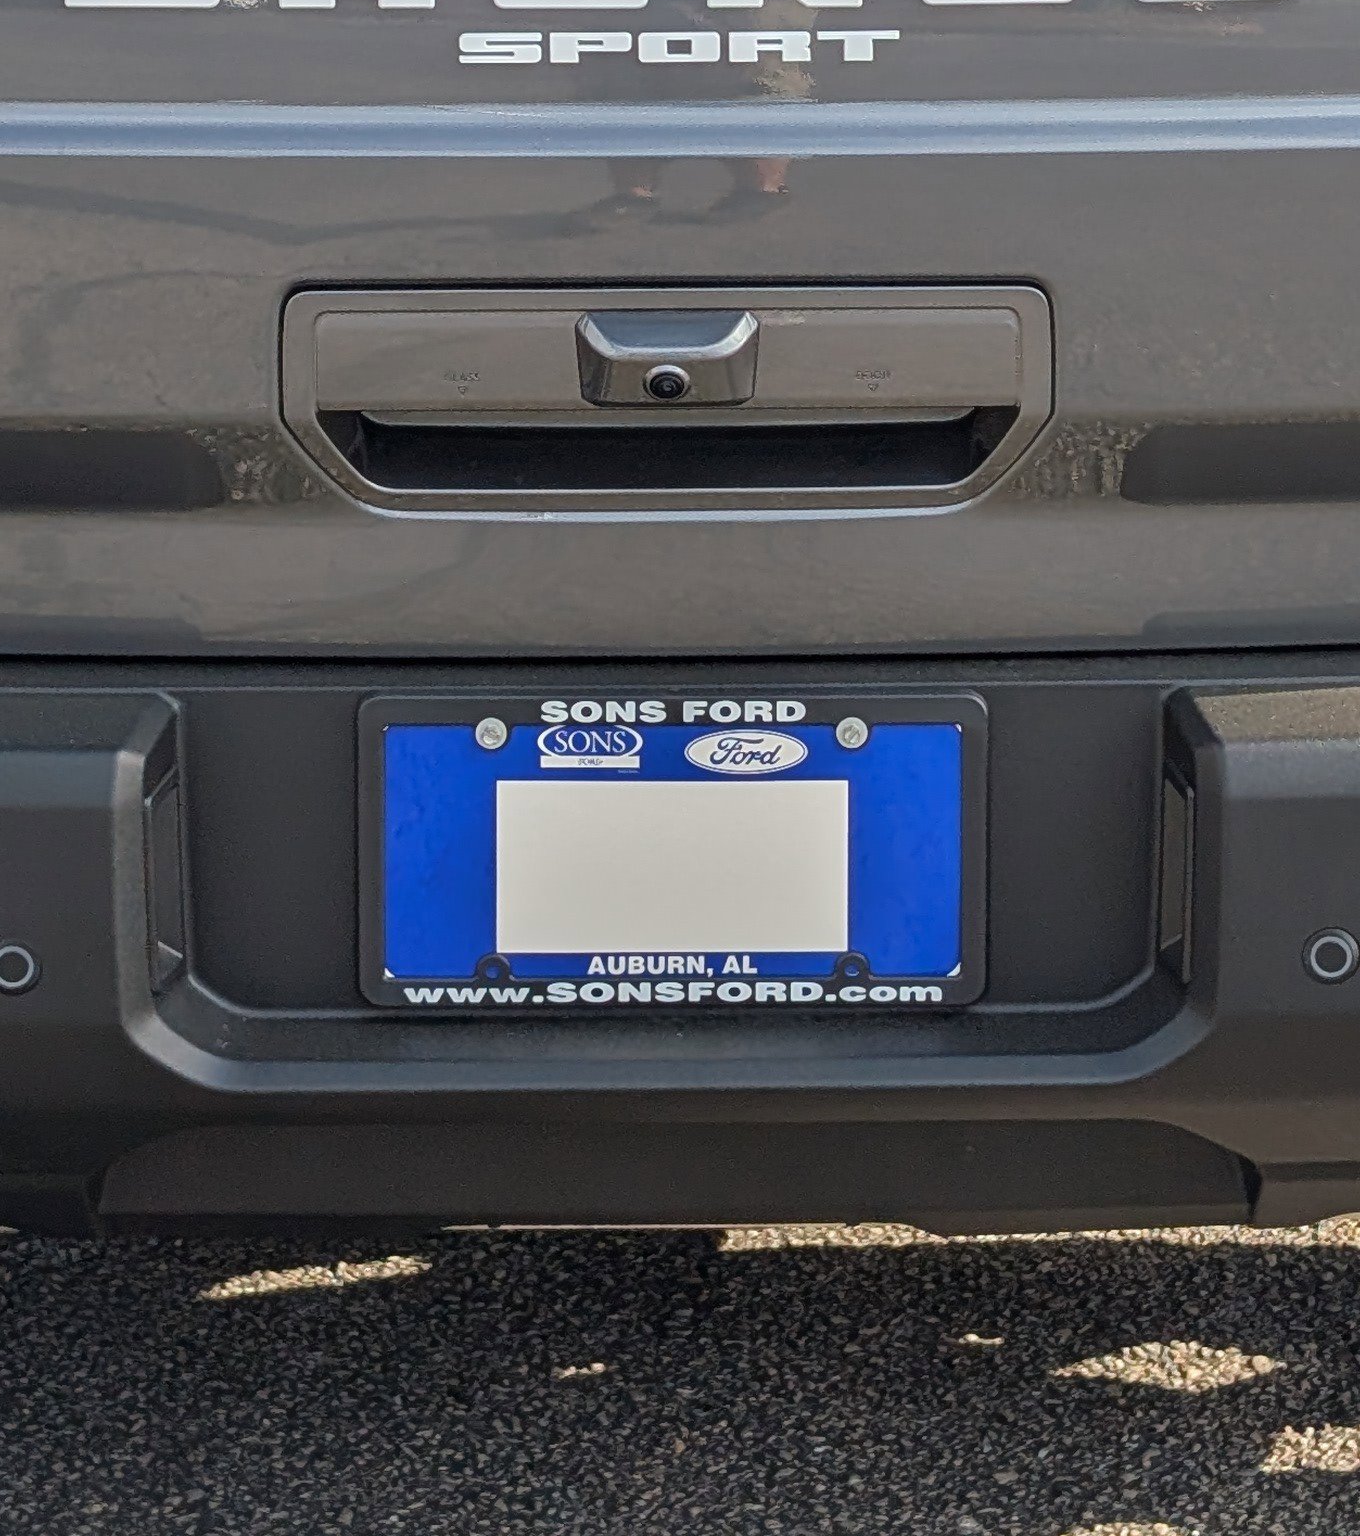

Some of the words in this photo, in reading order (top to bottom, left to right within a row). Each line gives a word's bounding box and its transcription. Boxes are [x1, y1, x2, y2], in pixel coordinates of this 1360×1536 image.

[458, 29, 901, 64] SPORT
[540, 700, 667, 724] SONS
[682, 700, 807, 724] FORD
[553, 729, 627, 755] SONS
[709, 736, 783, 766] Ford
[587, 955, 715, 978] AUBURN,
[722, 955, 758, 976] AL
[403, 981, 944, 1004] www.SONSFORD.com
